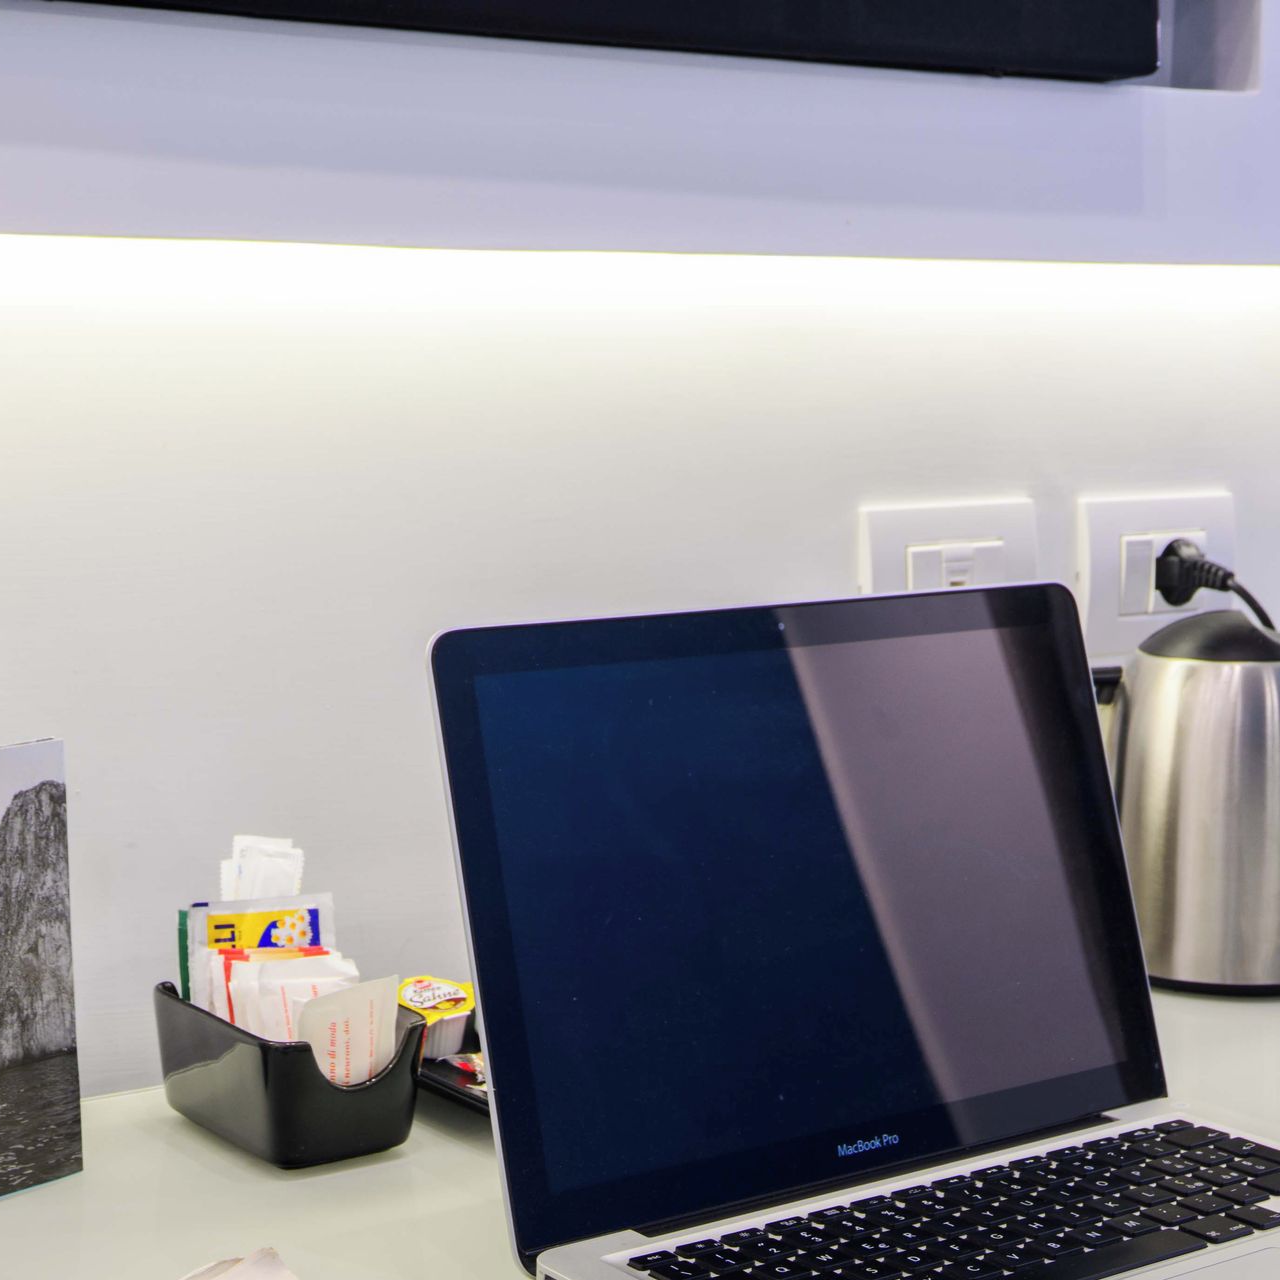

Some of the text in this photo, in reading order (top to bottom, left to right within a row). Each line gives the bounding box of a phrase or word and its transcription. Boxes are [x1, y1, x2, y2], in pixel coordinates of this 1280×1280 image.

[327, 1022, 337, 1047] moda
[327, 1049, 337, 1059] di
[837, 1134, 899, 1157] MacBook Pro
[1105, 1200, 1119, 1208] K
[1029, 1221, 1044, 1229] H
[1124, 1220, 1140, 1228] M
[903, 1231, 916, 1239] R
[816, 1253, 833, 1261] W
